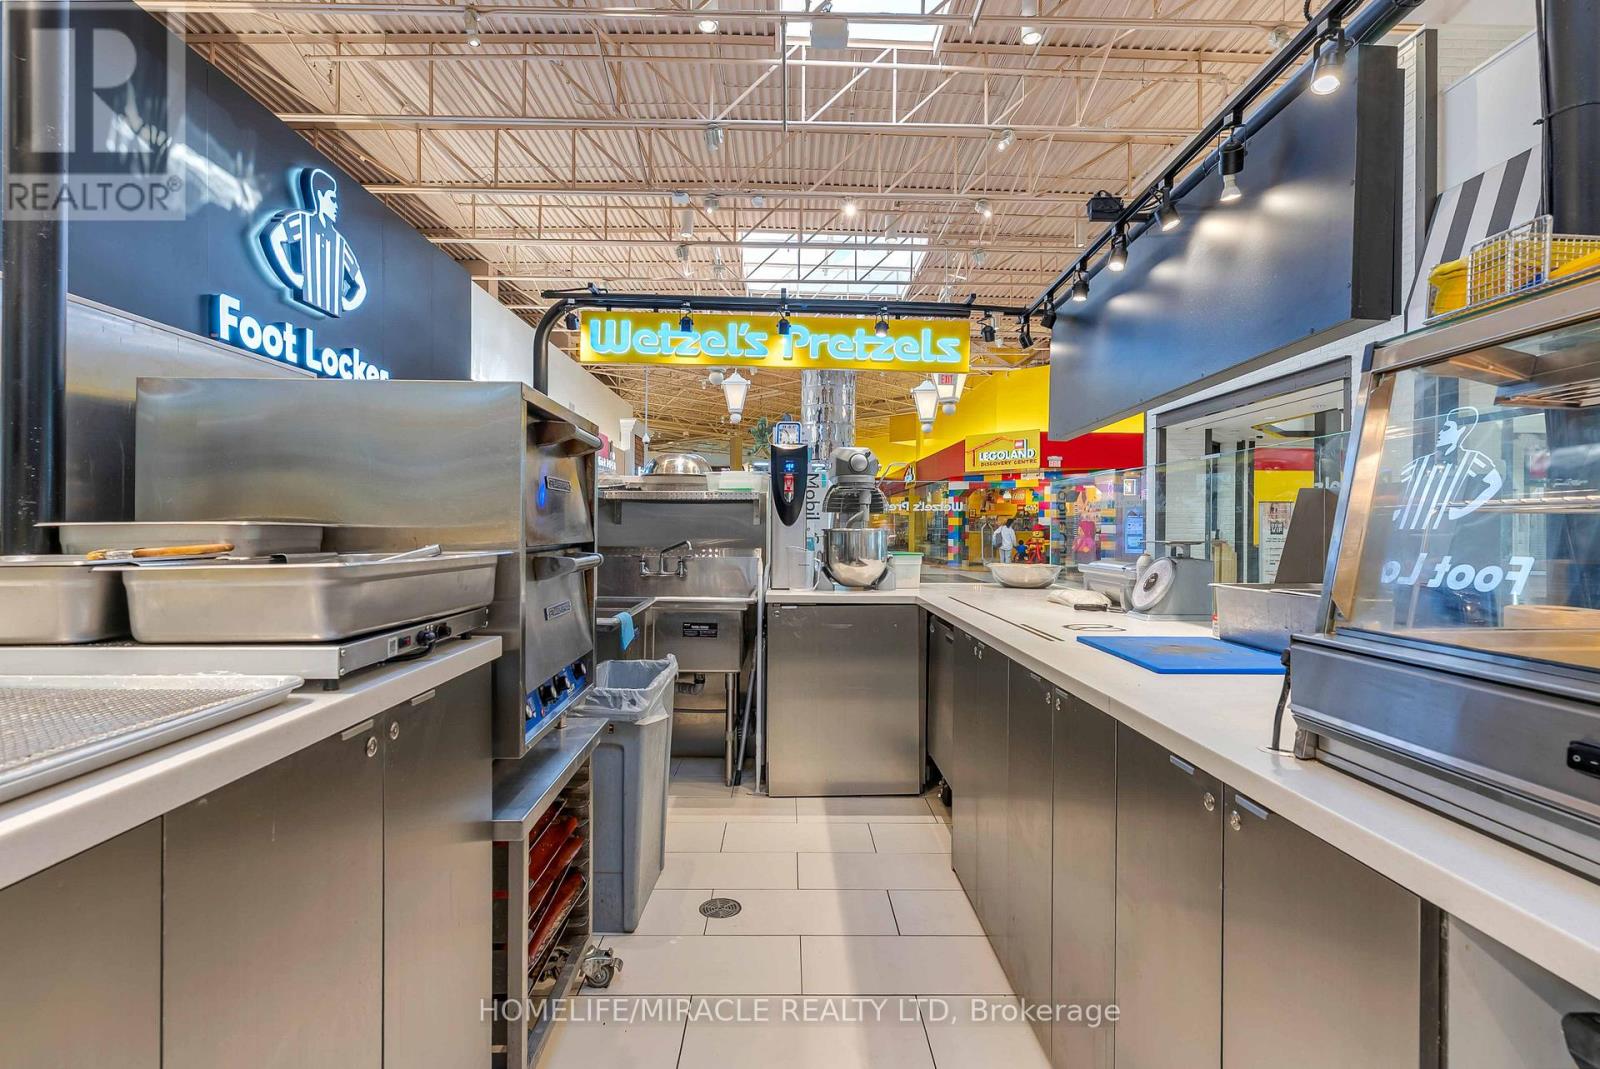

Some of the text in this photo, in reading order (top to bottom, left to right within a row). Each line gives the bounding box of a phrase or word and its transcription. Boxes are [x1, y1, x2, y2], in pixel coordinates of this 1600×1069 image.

[219, 293, 298, 364] Foot
[589, 319, 961, 363] Wetzel's Pretzels
[979, 448, 1036, 460] LEGOLAND
